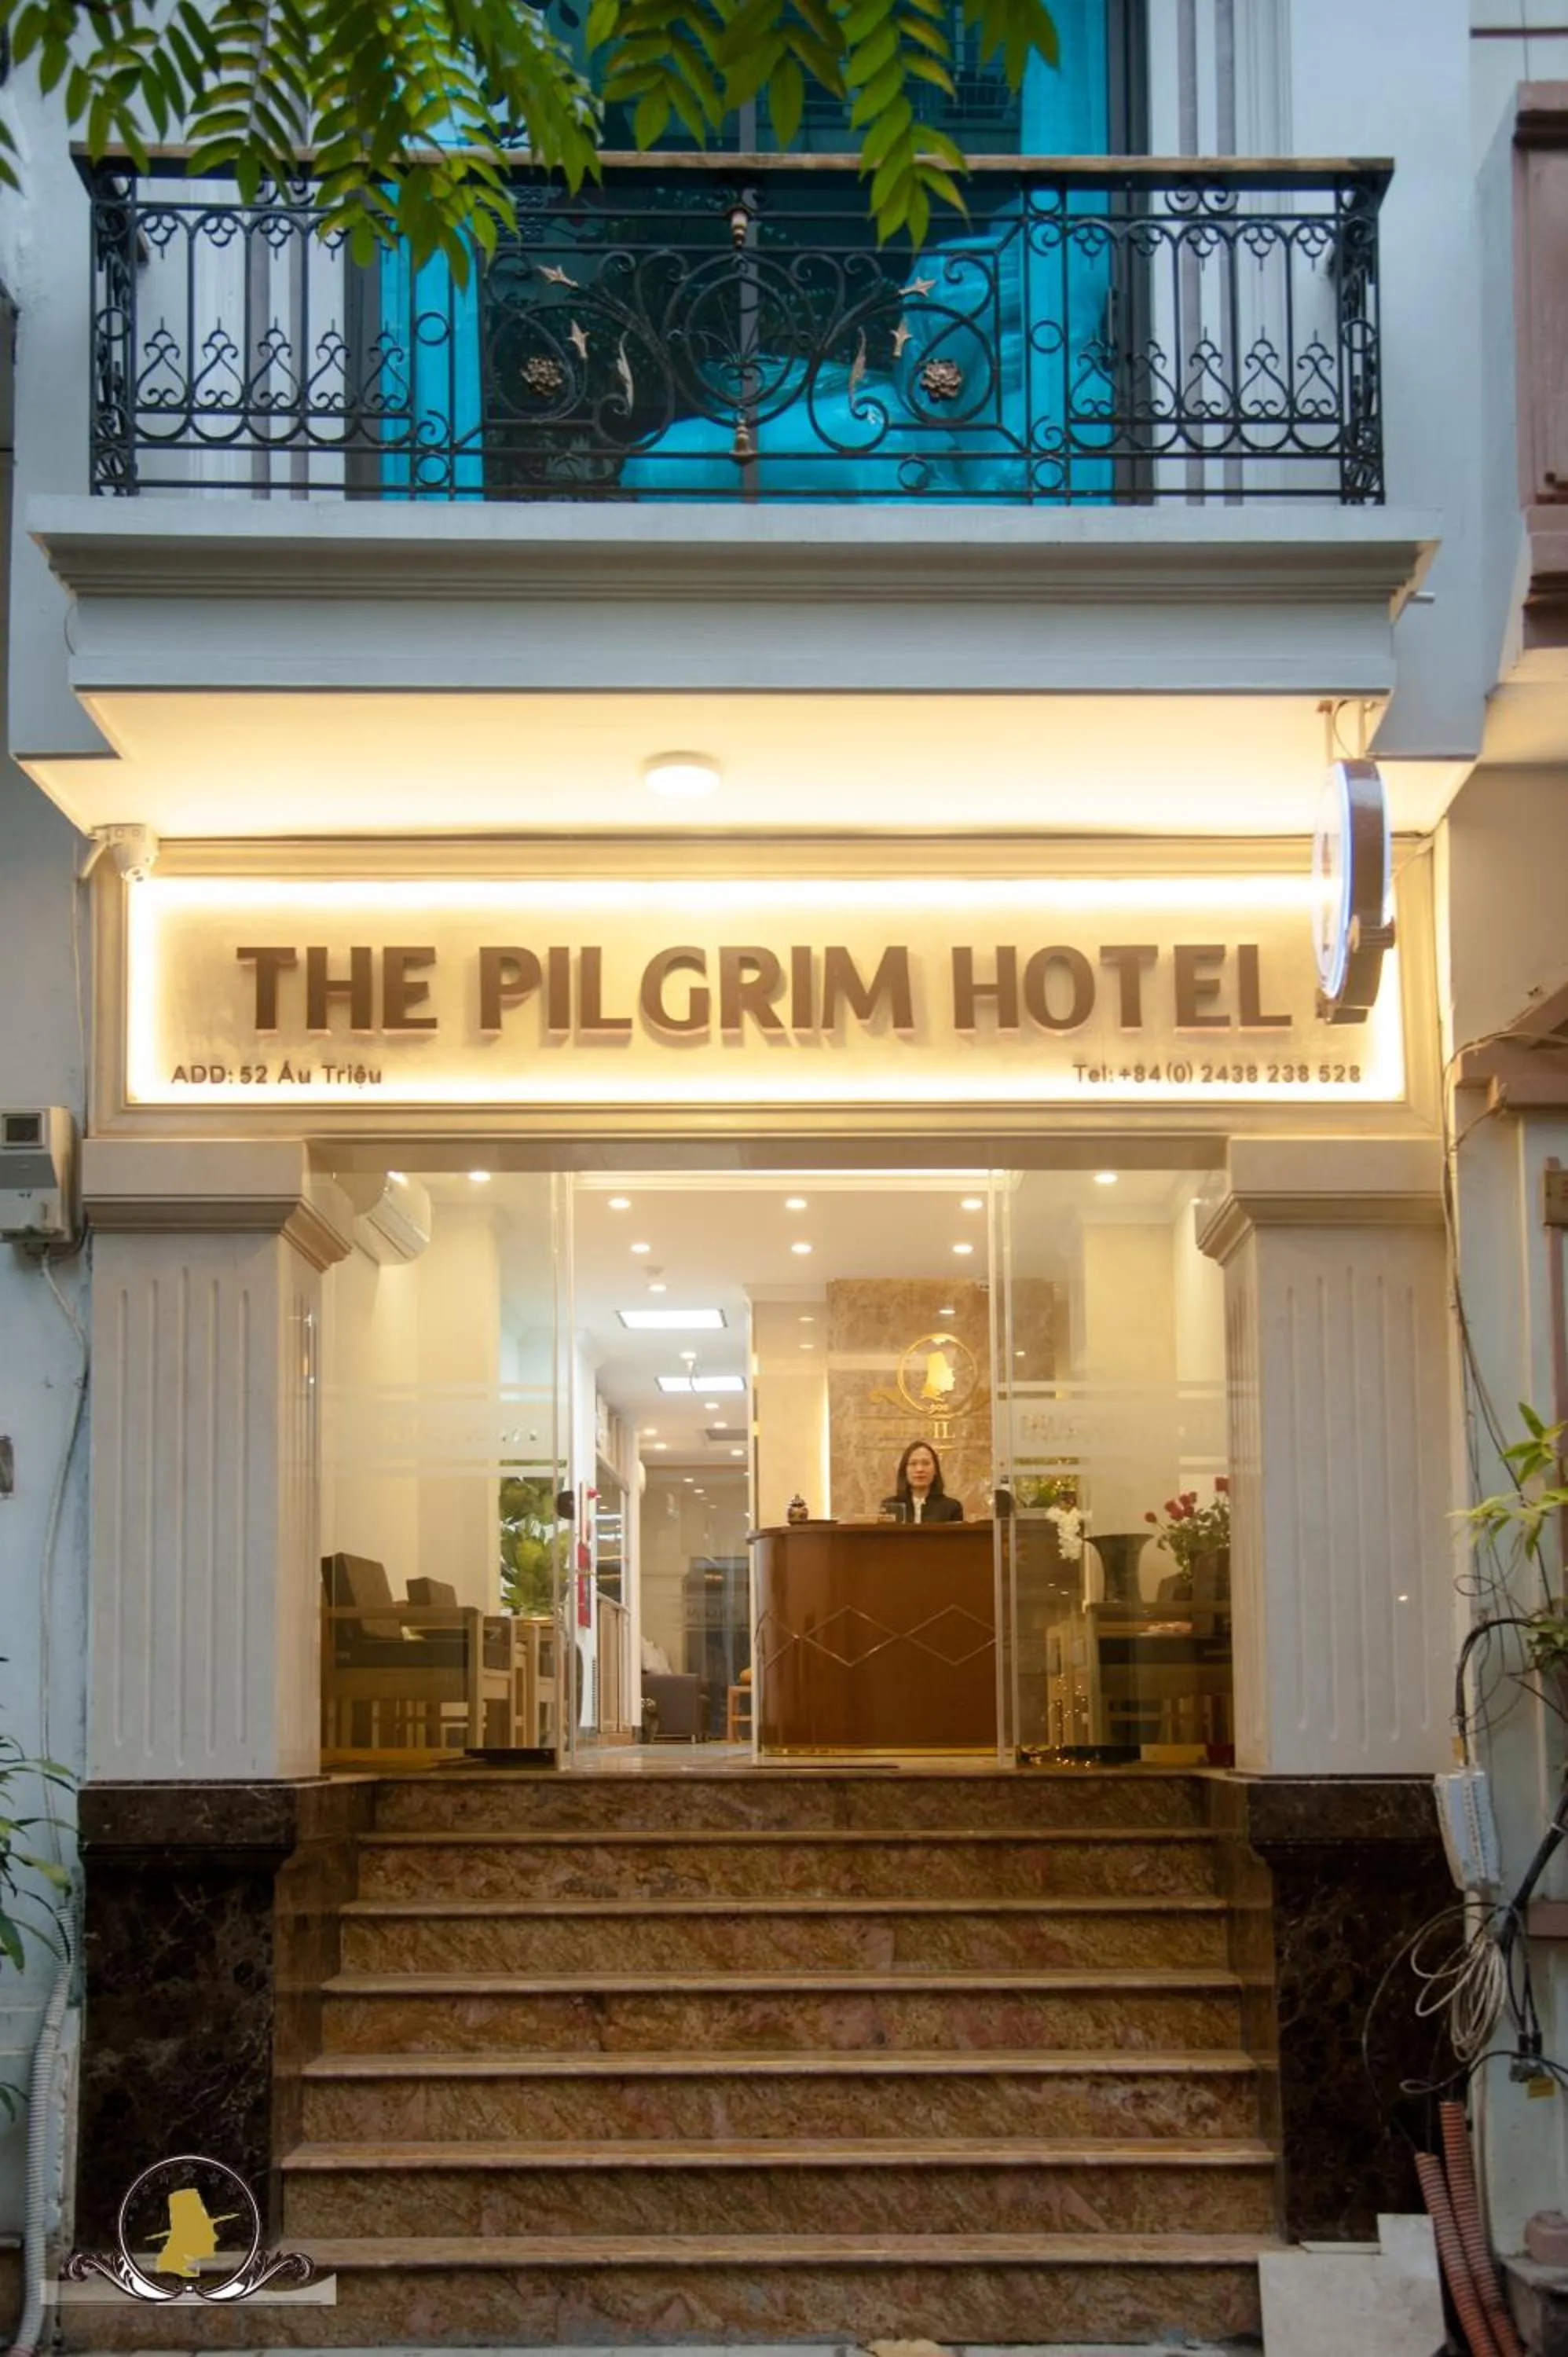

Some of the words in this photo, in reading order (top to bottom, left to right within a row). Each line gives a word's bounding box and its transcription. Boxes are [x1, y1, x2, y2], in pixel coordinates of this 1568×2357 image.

[236, 946, 439, 1033] THE
[478, 945, 915, 1034] PILGRIM
[951, 944, 1293, 1034] HOTEL
[1200, 1063, 1258, 1083] 2438
[1267, 1063, 1310, 1083] 238
[1318, 1063, 1361, 1083] 528
